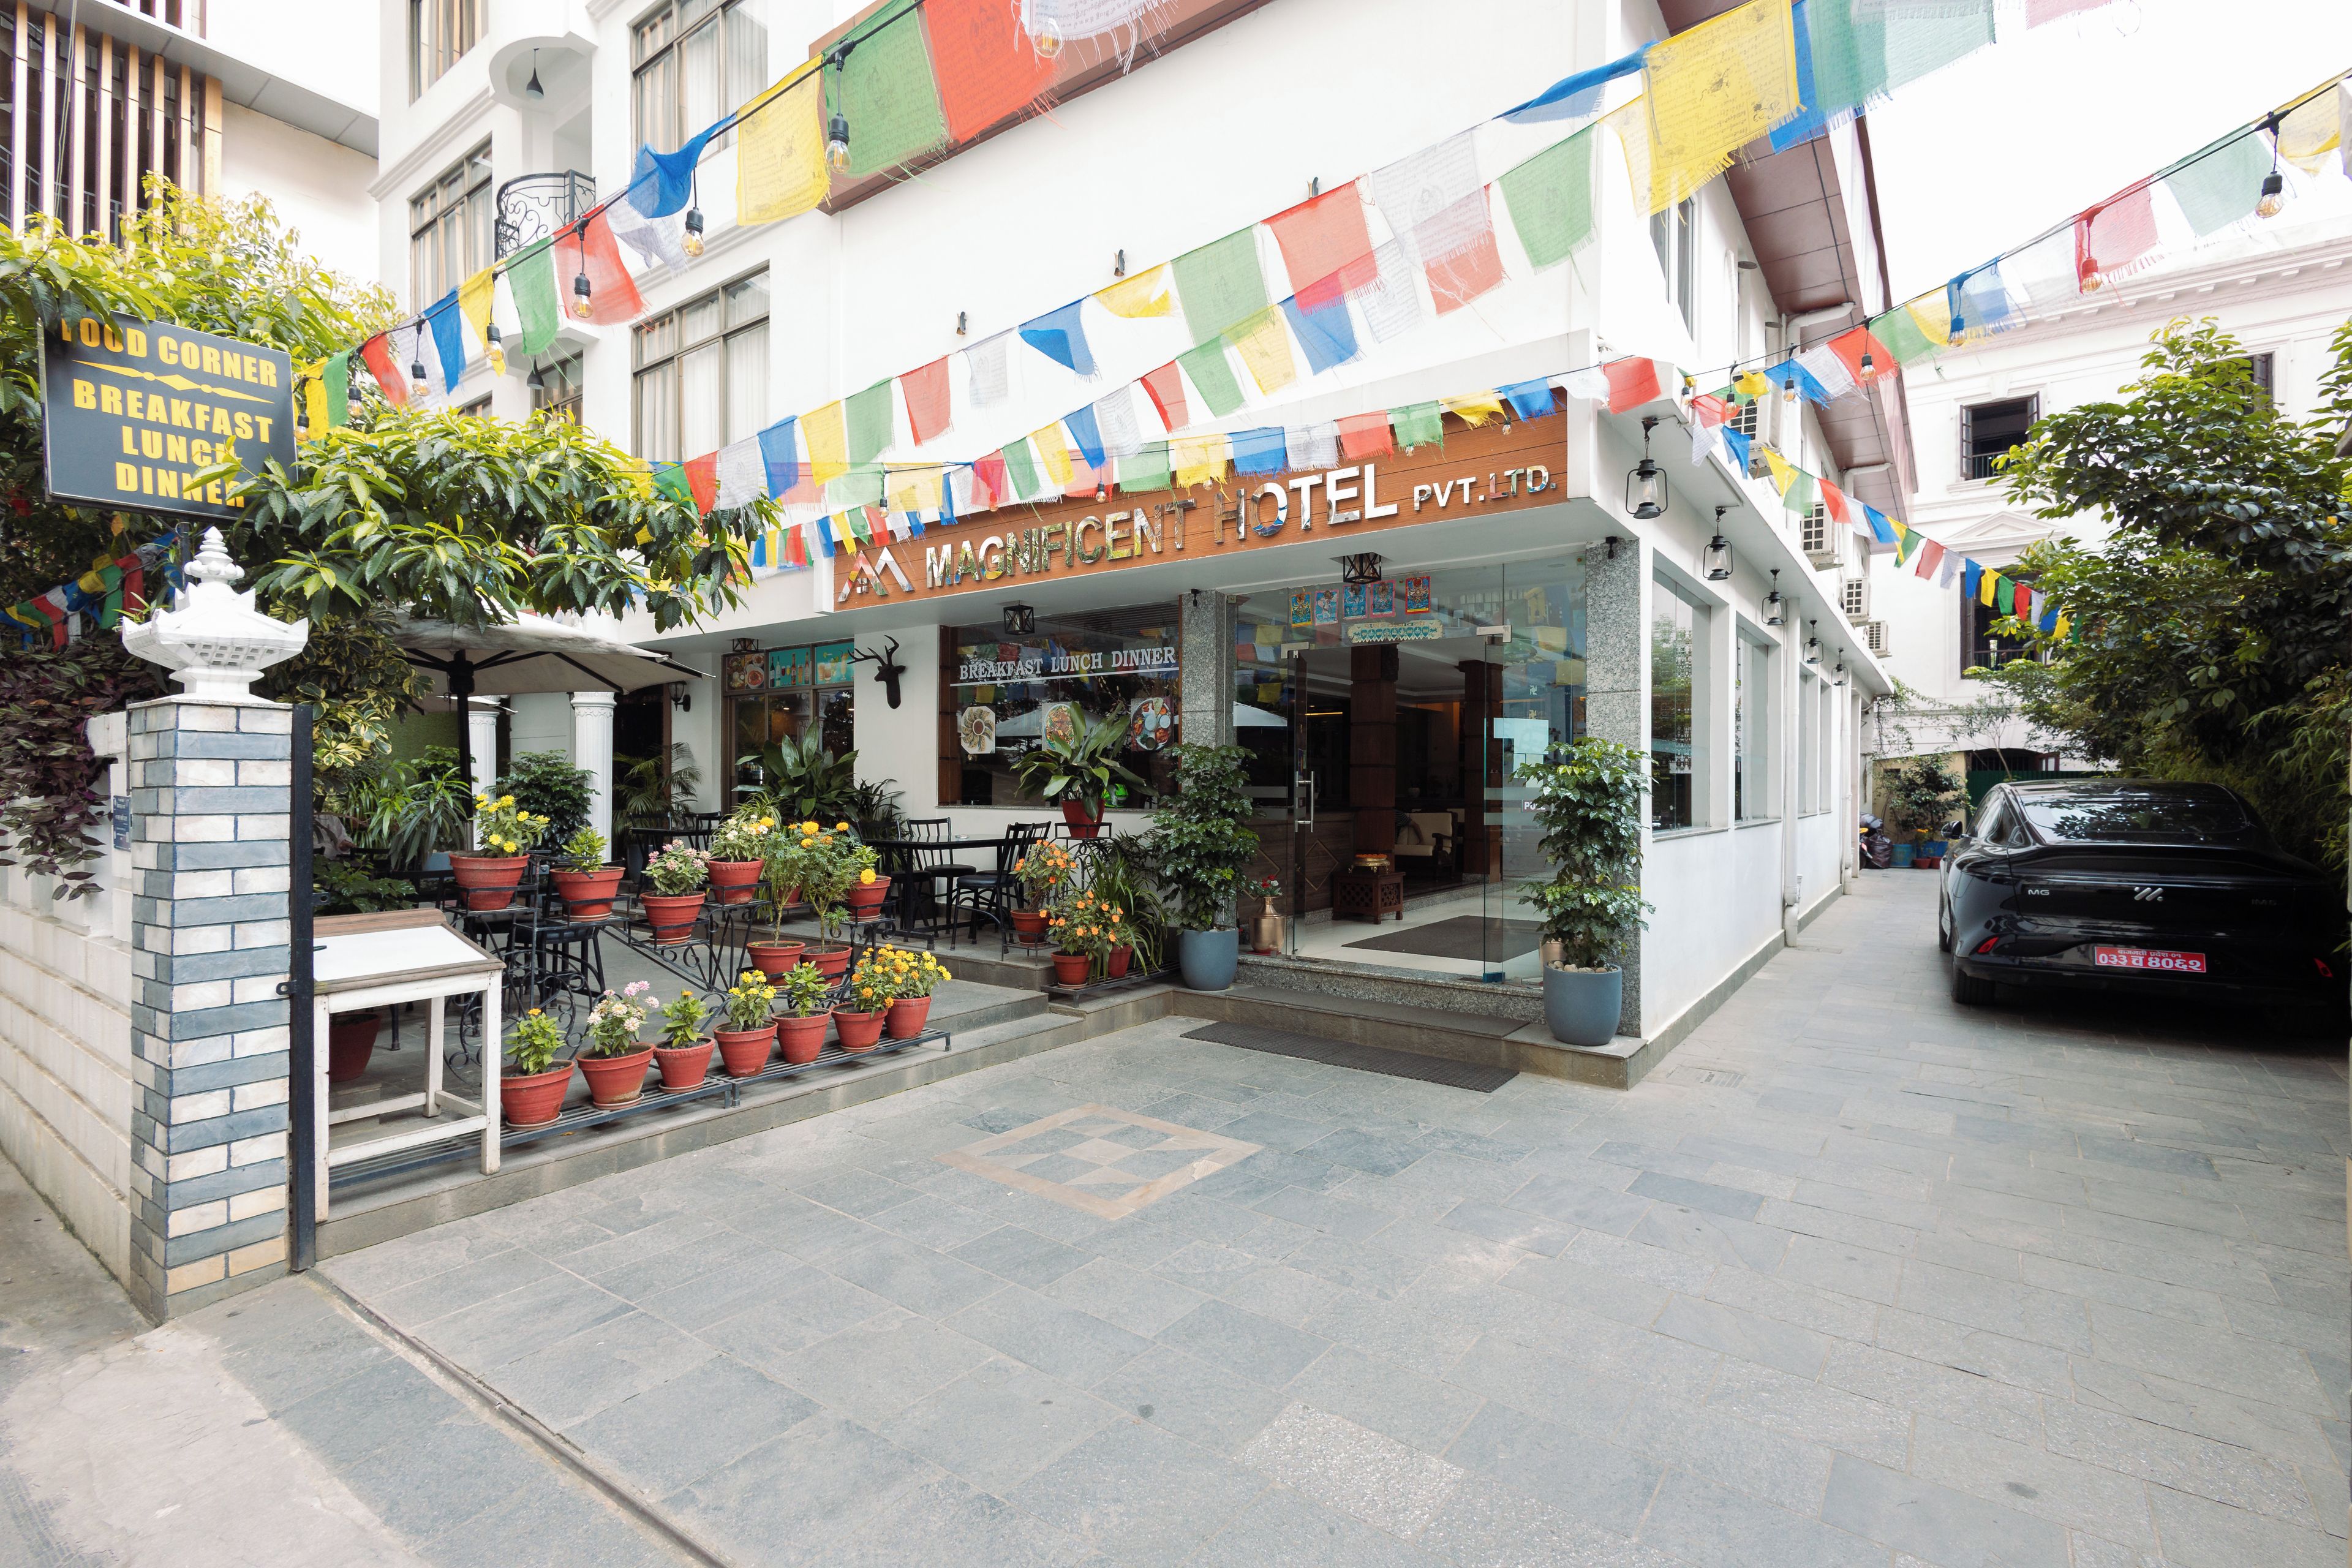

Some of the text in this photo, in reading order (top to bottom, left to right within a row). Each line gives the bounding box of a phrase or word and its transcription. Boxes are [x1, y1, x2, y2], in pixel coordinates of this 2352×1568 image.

[157, 335, 277, 388] CORNER
[73, 379, 273, 443] BREAKFAST
[925, 498, 1197, 589] MAGNIFICENT
[1214, 463, 1400, 544] HOTEL
[959, 646, 1177, 680] BREAKFAST LUNCH DINNER
[2099, 954, 2128, 965] ०३३
[2147, 957, 2201, 970] ४०६२
